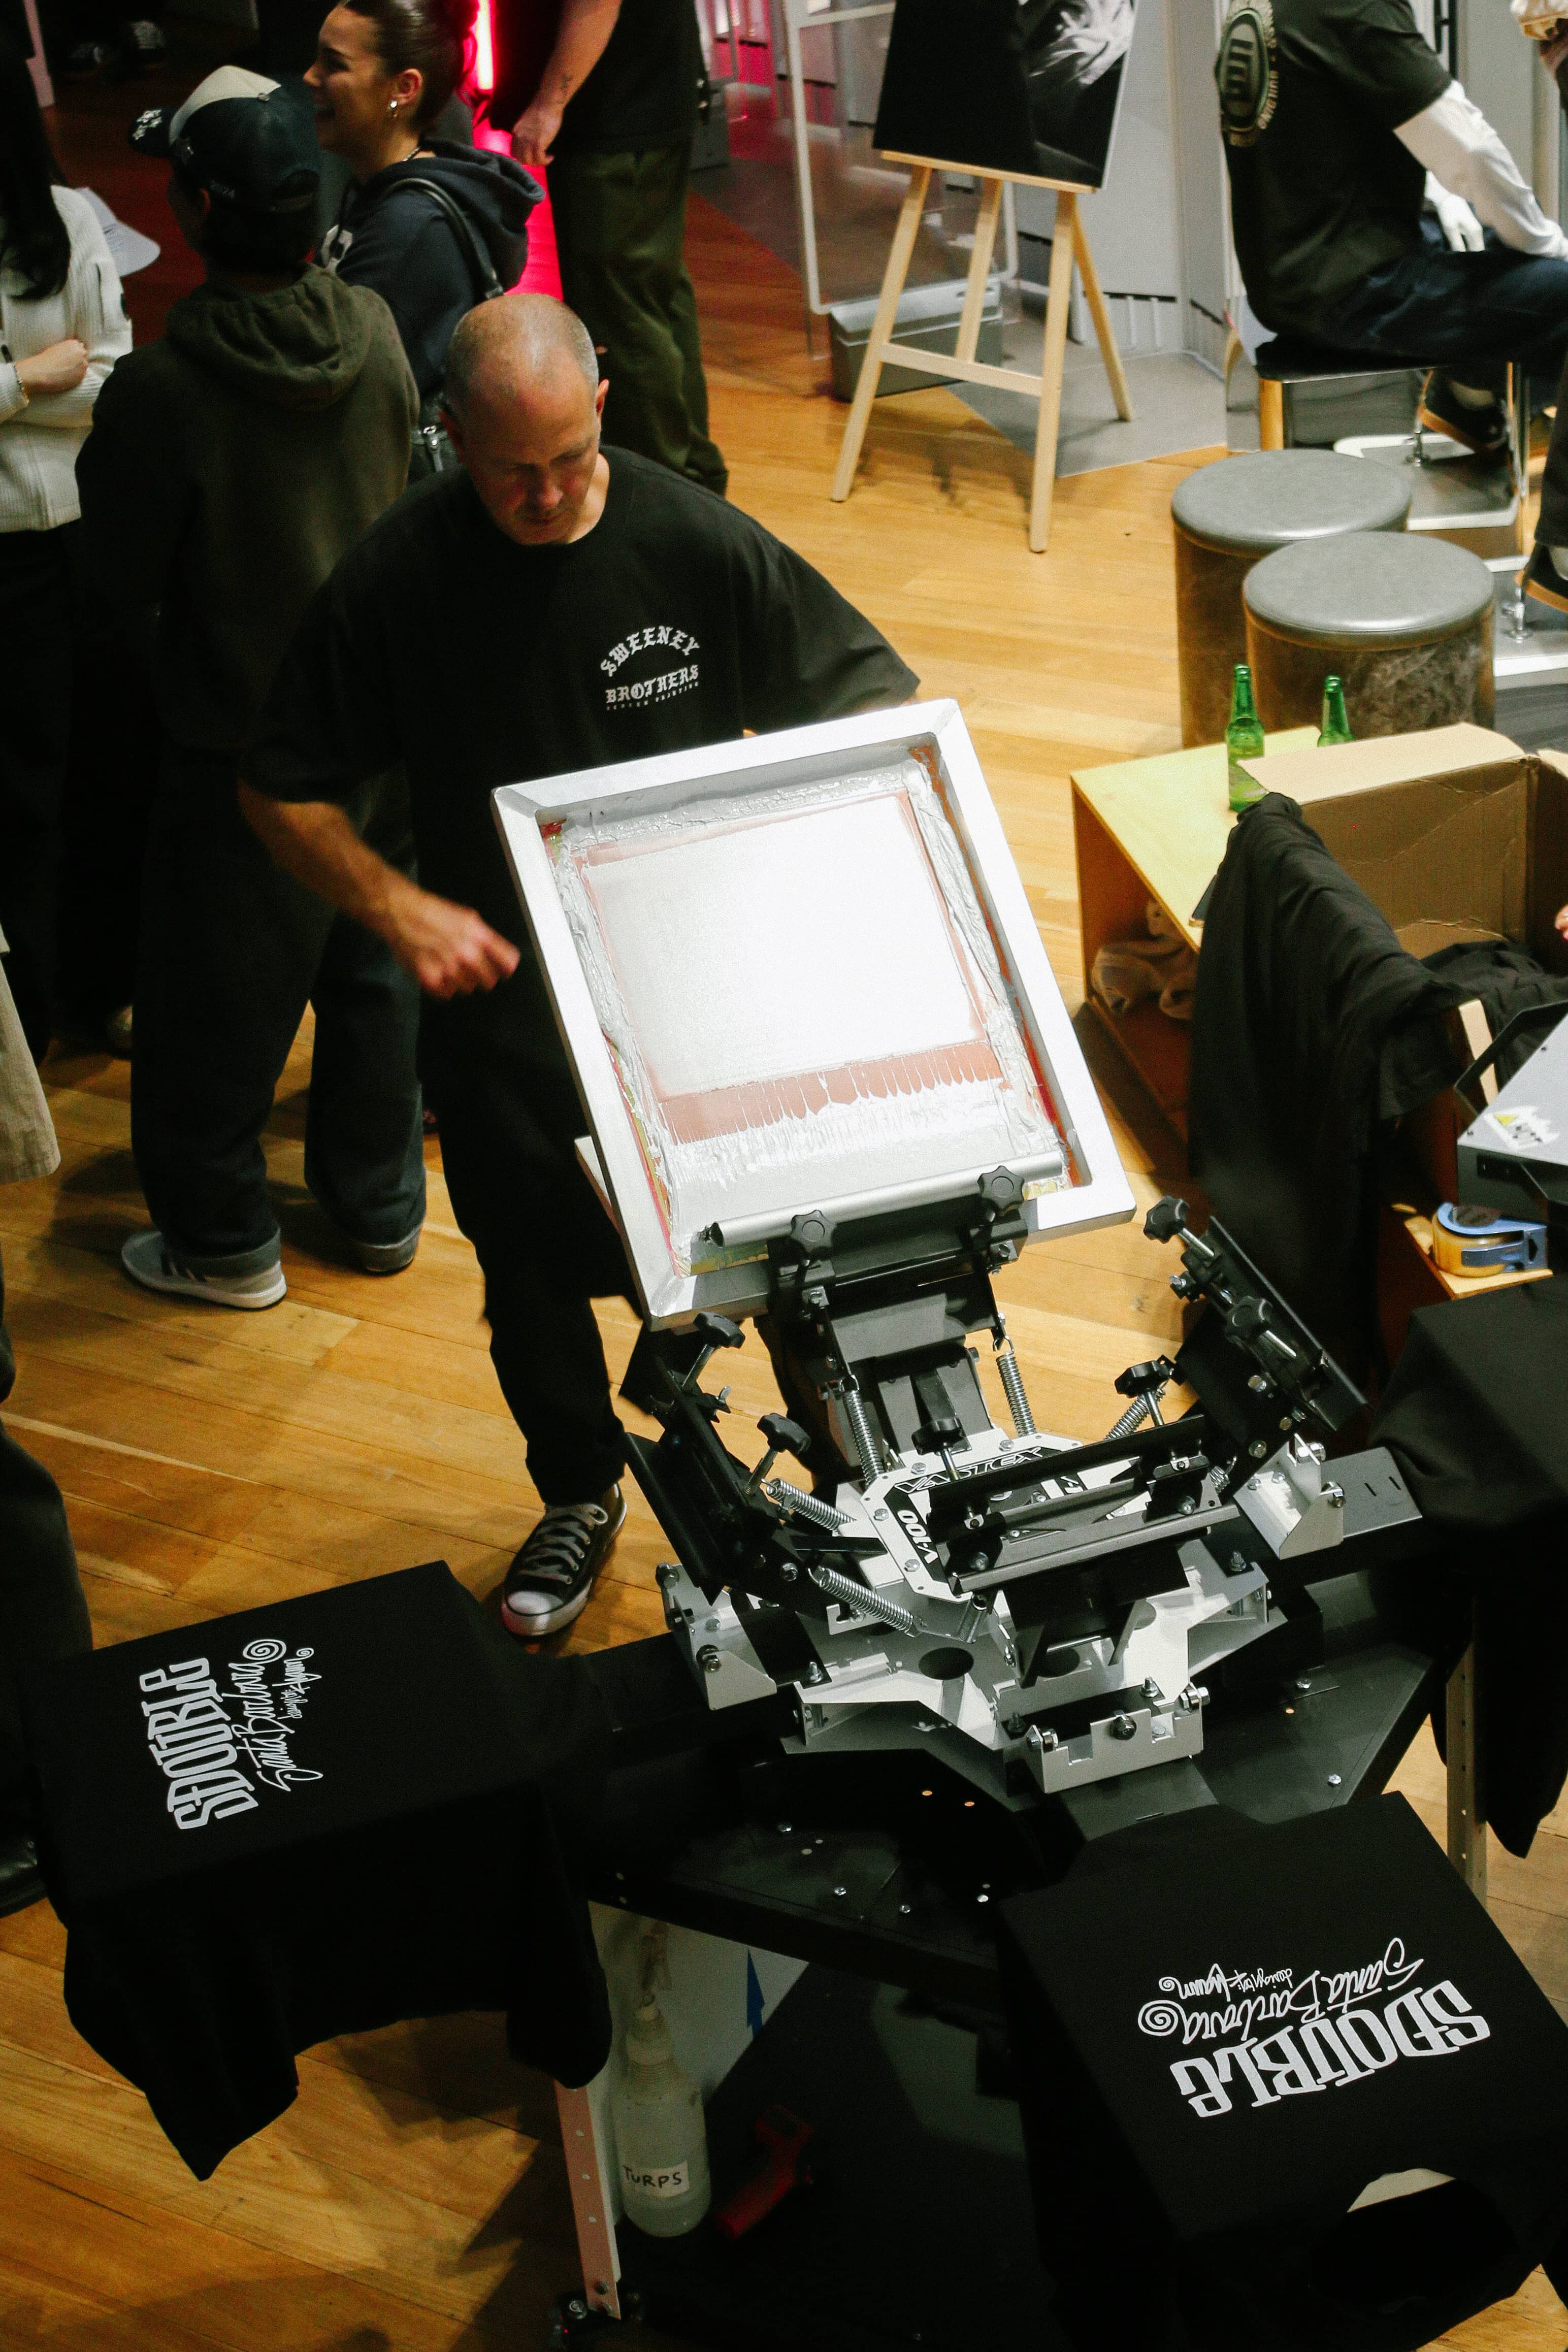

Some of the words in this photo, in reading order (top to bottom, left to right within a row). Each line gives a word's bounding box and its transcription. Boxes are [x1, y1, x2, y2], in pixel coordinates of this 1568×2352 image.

[600, 625, 700, 677] SWEENEY
[605, 664, 699, 703] BROTHERS
[222, 1639, 295, 1738] Barbara
[236, 1734, 323, 1792] Santa
[1321, 1937, 1424, 2014] Santa
[1137, 1970, 1325, 2044] Barbara
[623, 2164, 682, 2189] TURPS
